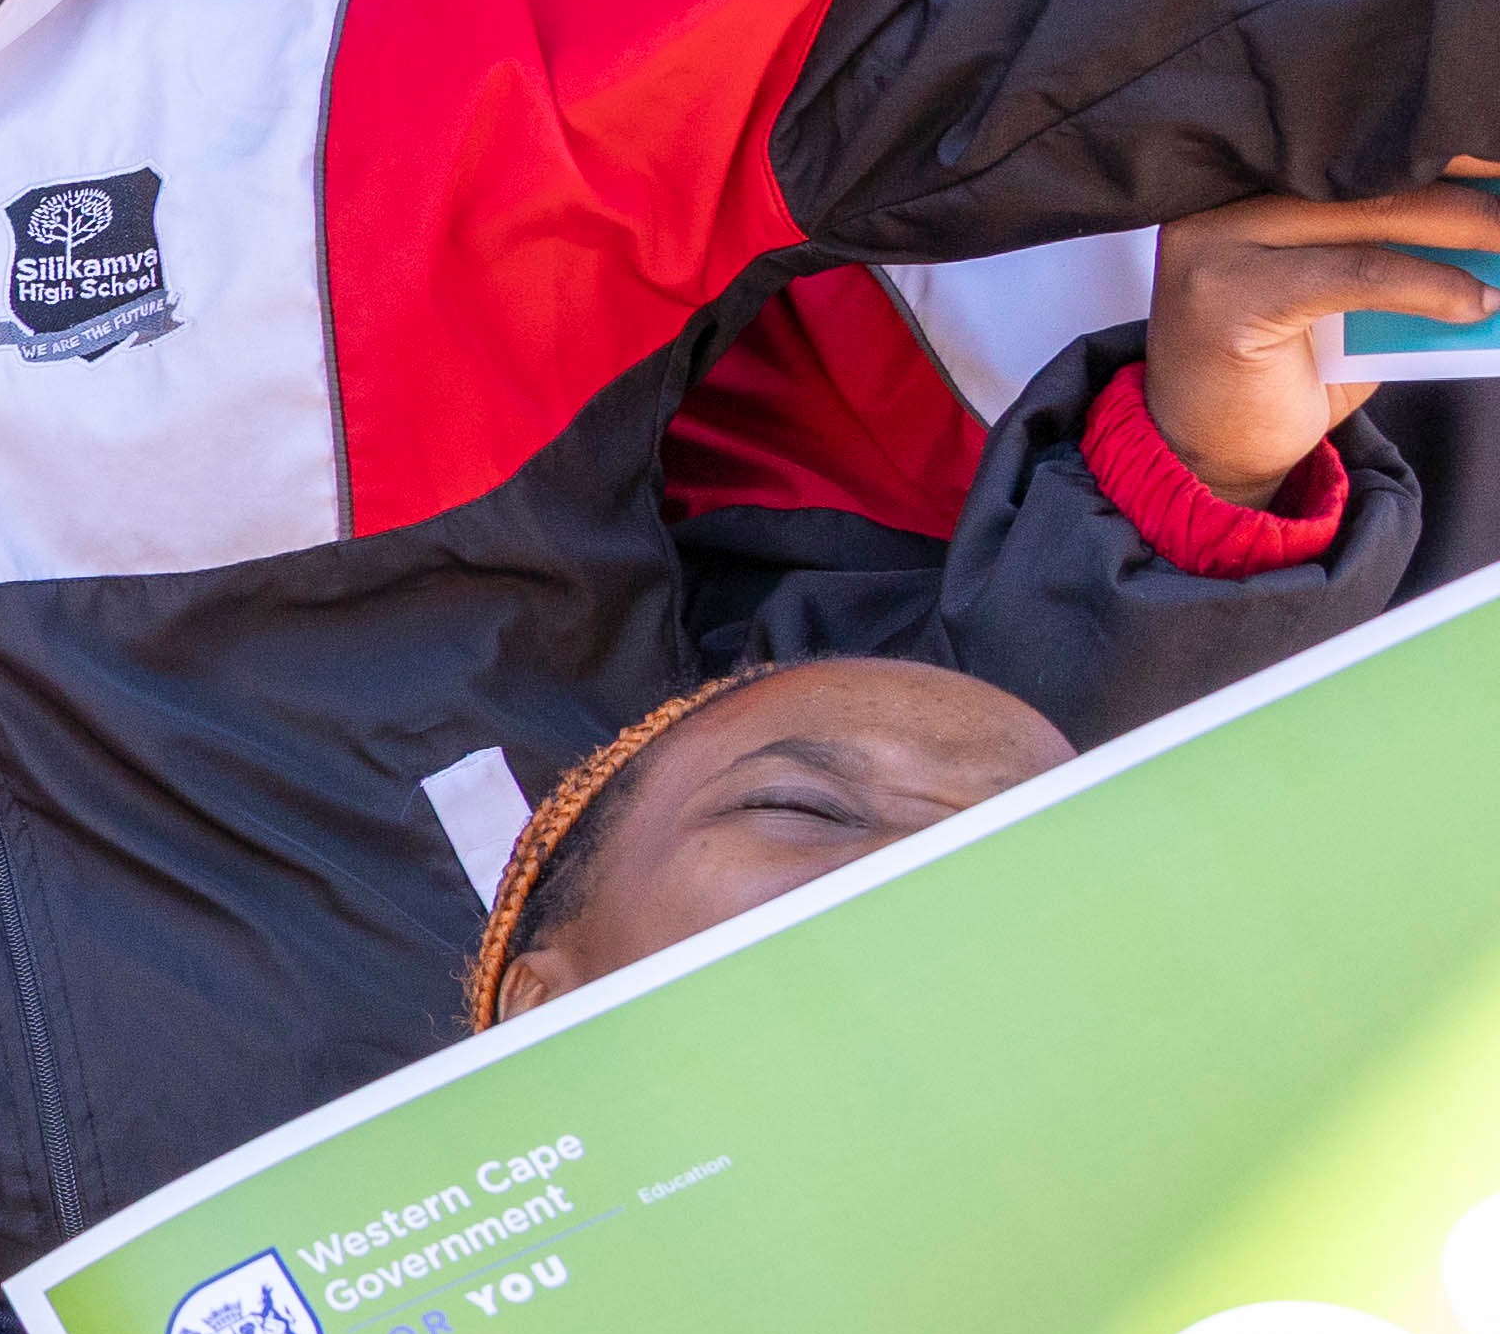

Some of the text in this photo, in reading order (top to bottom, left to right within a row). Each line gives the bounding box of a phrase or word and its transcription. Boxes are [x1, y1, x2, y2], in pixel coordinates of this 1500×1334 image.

[15, 247, 159, 283] Silikamva
[18, 268, 158, 305] High School
[20, 298, 165, 360] WE ARE THE FUTURE
[296, 1133, 586, 1275] Western Cape
[636, 1152, 732, 1206] Education
[322, 1183, 576, 1314] Government
[464, 1253, 570, 1318] YOU
